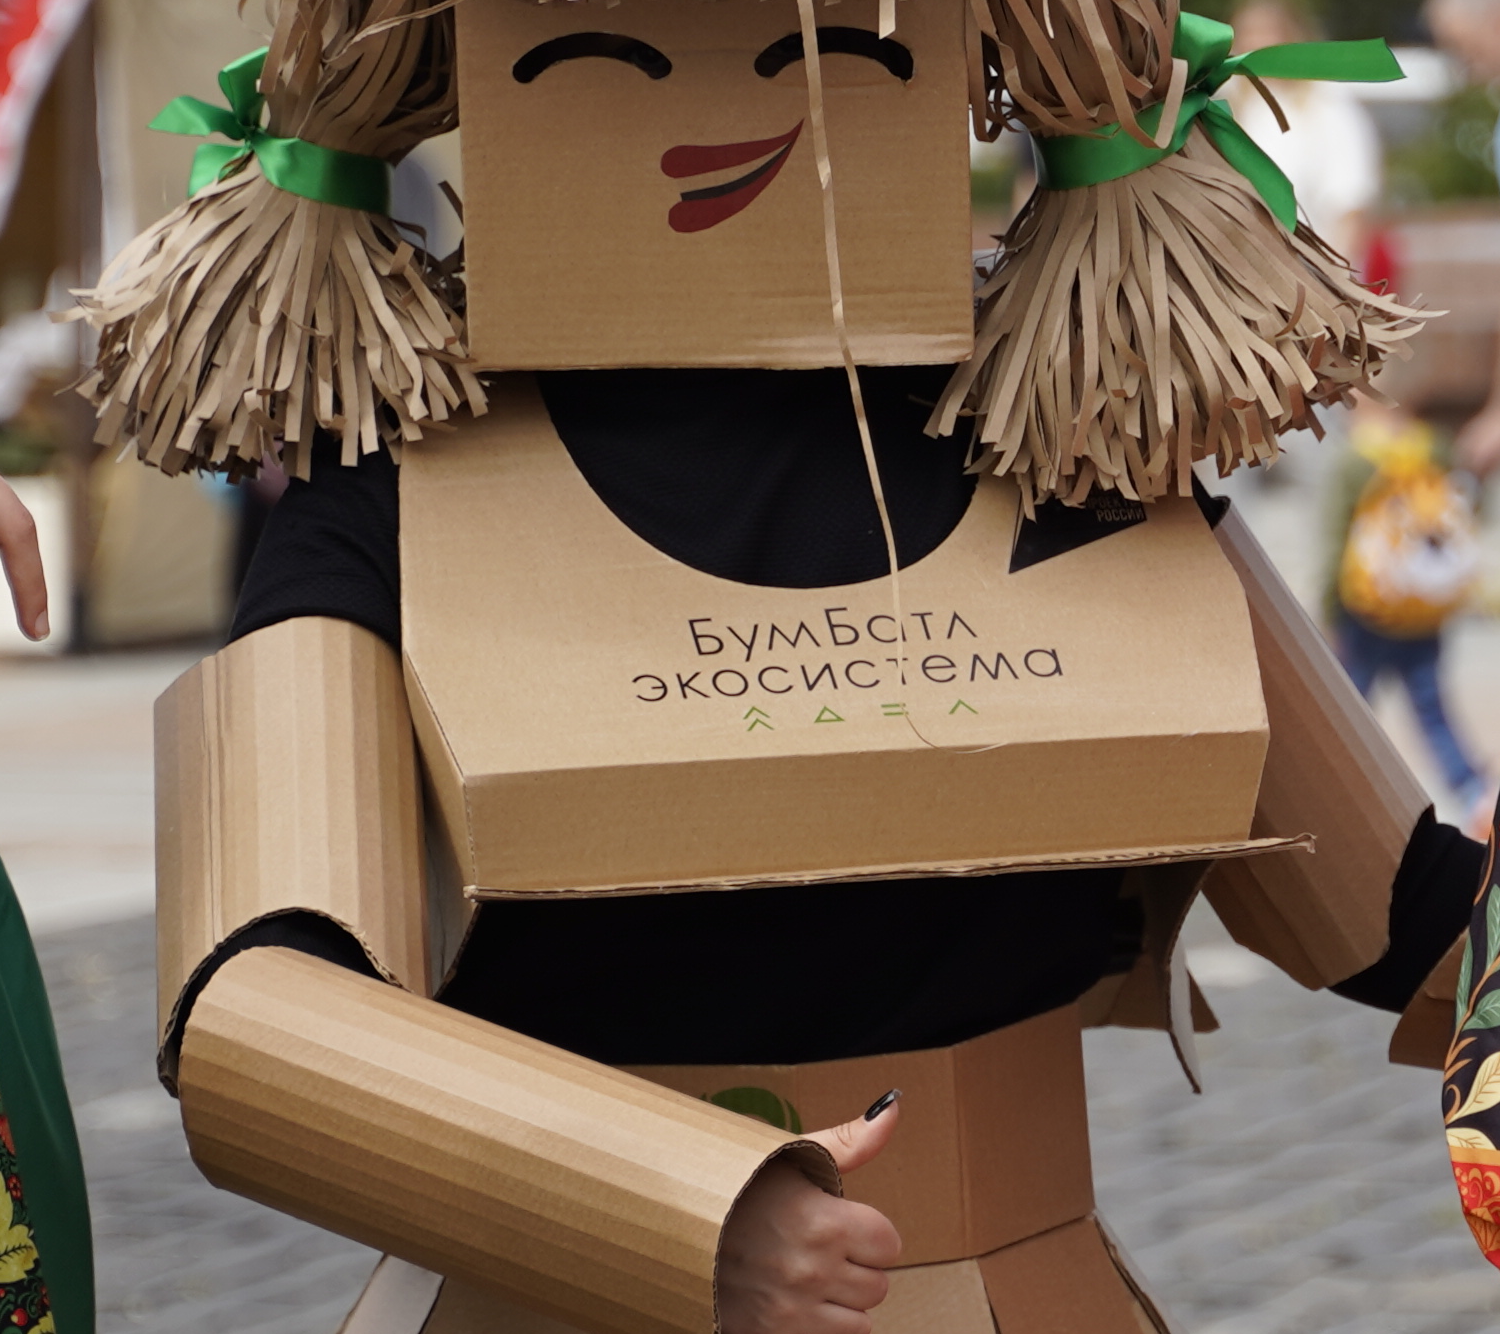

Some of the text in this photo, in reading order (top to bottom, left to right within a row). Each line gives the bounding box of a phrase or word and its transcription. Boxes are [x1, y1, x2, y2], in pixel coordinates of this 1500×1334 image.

[1097, 508, 1144, 522] РОССИИ
[687, 606, 979, 663] БумБатл
[631, 646, 1064, 704] экосистема
